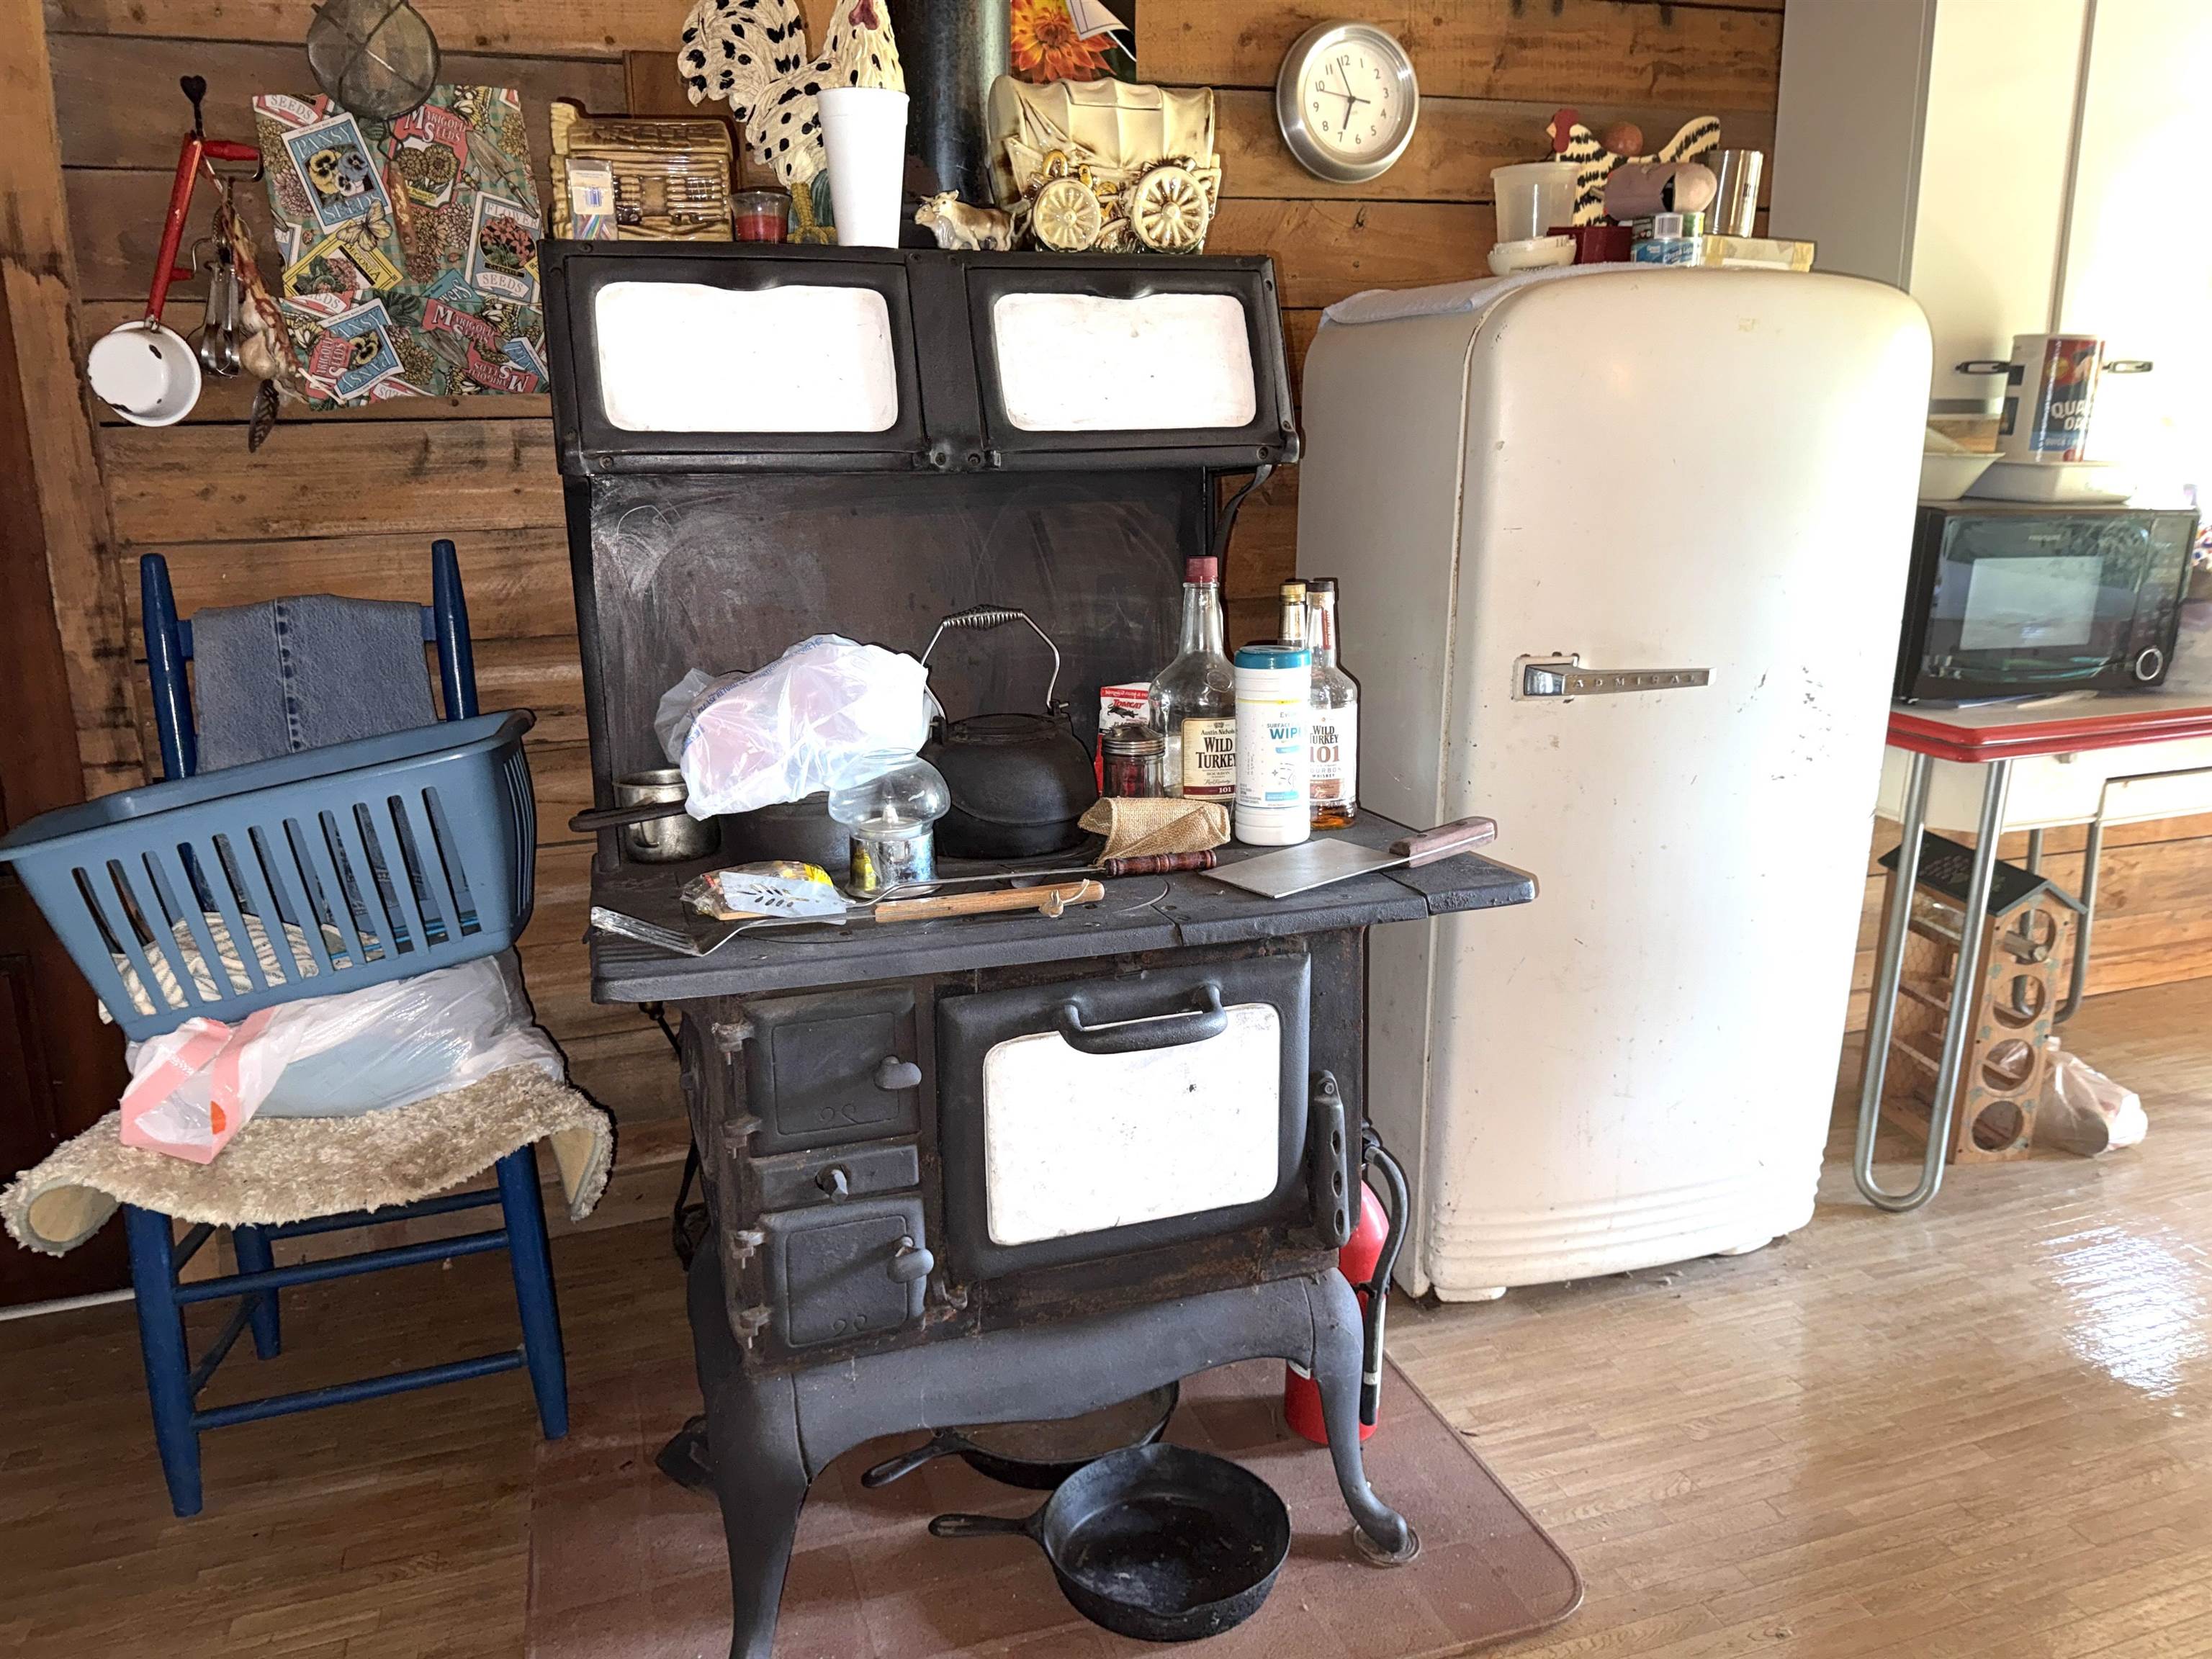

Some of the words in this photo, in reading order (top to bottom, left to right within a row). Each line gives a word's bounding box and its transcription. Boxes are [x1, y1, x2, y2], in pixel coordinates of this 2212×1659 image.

[1341, 55, 1350, 66] 12
[1325, 63, 1334, 76] 11
[1374, 68, 1381, 80] 2
[1315, 80, 1325, 92] 10
[1383, 88, 1390, 99] 3
[270, 95, 313, 120] SEEDS
[1313, 102, 1319, 112] 9
[1380, 108, 1387, 119] 4
[404, 106, 467, 132] MARIGOLD
[1322, 120, 1329, 132] 8
[1370, 125, 1377, 136] 5
[423, 123, 461, 143] SEEDS
[1337, 132, 1344, 143] 7
[1355, 134, 1362, 145] 6
[295, 126, 353, 159] PANSY
[485, 202, 539, 228] FLOWER
[344, 242, 381, 282] BEGONIA
[482, 274, 523, 293] SEEDS
[432, 305, 495, 337] MARIGOLD
[474, 361, 513, 379] SEEDS
[468, 369, 530, 393] MARIGOLD
[1573, 675, 1697, 688] ADMIRAL
[1113, 698, 1145, 709] TOMCAT
[1313, 725, 1335, 735] WILD
[1204, 737, 1233, 753] WILD
[1310, 732, 1339, 745] TURKEY
[1310, 745, 1340, 763] 101
